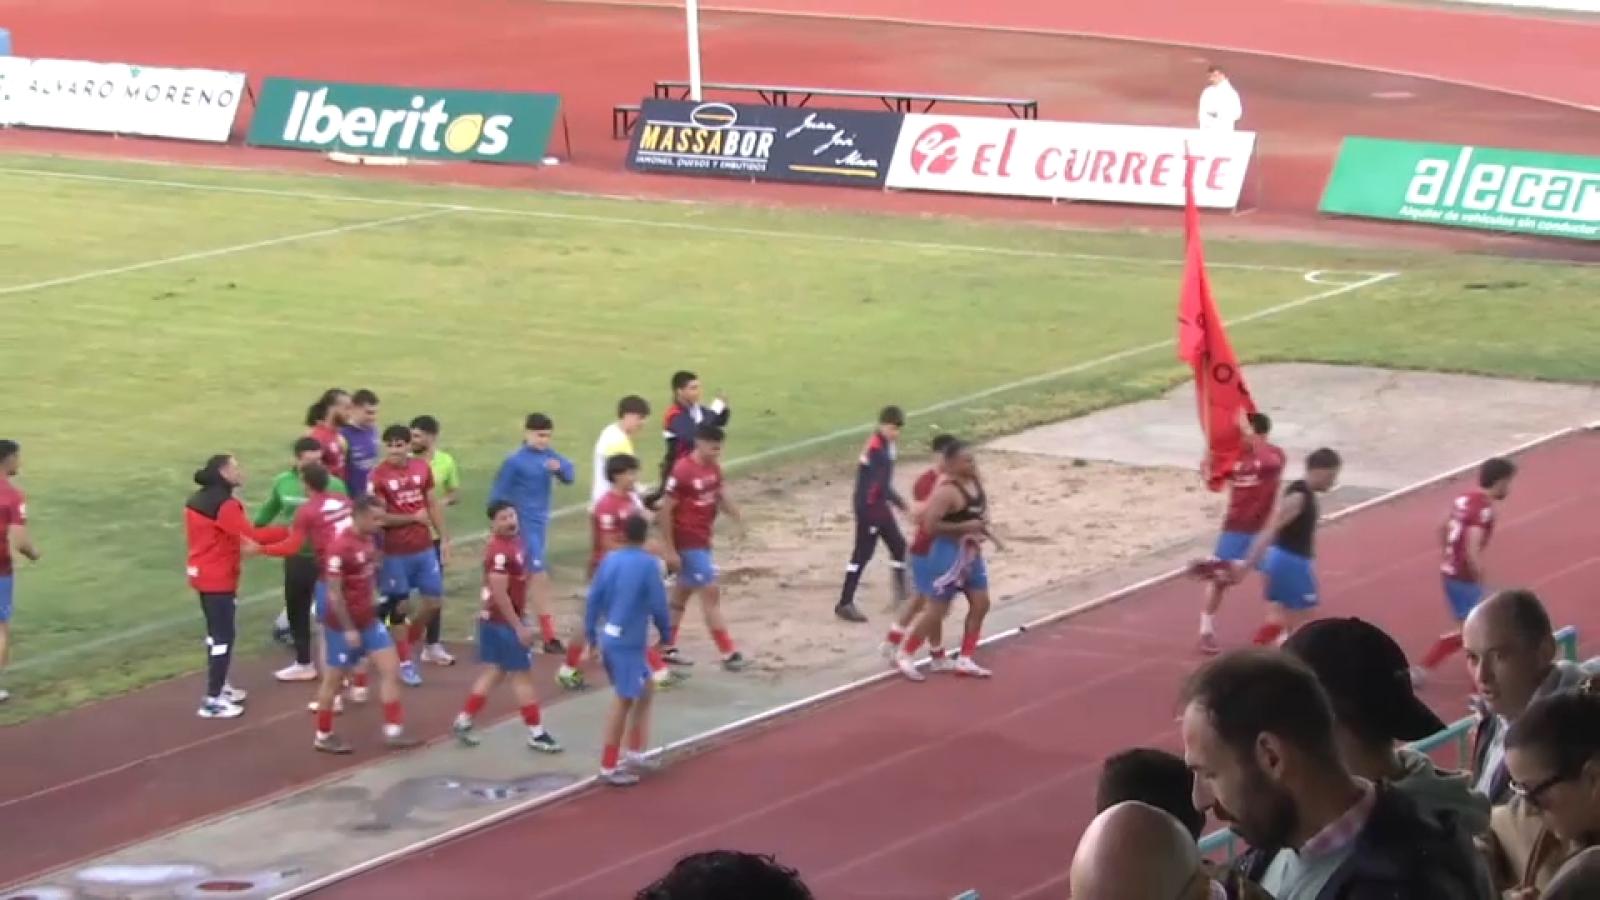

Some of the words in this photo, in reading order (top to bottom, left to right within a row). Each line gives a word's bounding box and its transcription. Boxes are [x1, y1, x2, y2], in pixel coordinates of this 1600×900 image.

[125, 84, 234, 108] MORENO
[281, 86, 515, 155] Iberitos
[639, 125, 775, 158] MASSABOR
[1034, 147, 1233, 190] CURRETE
